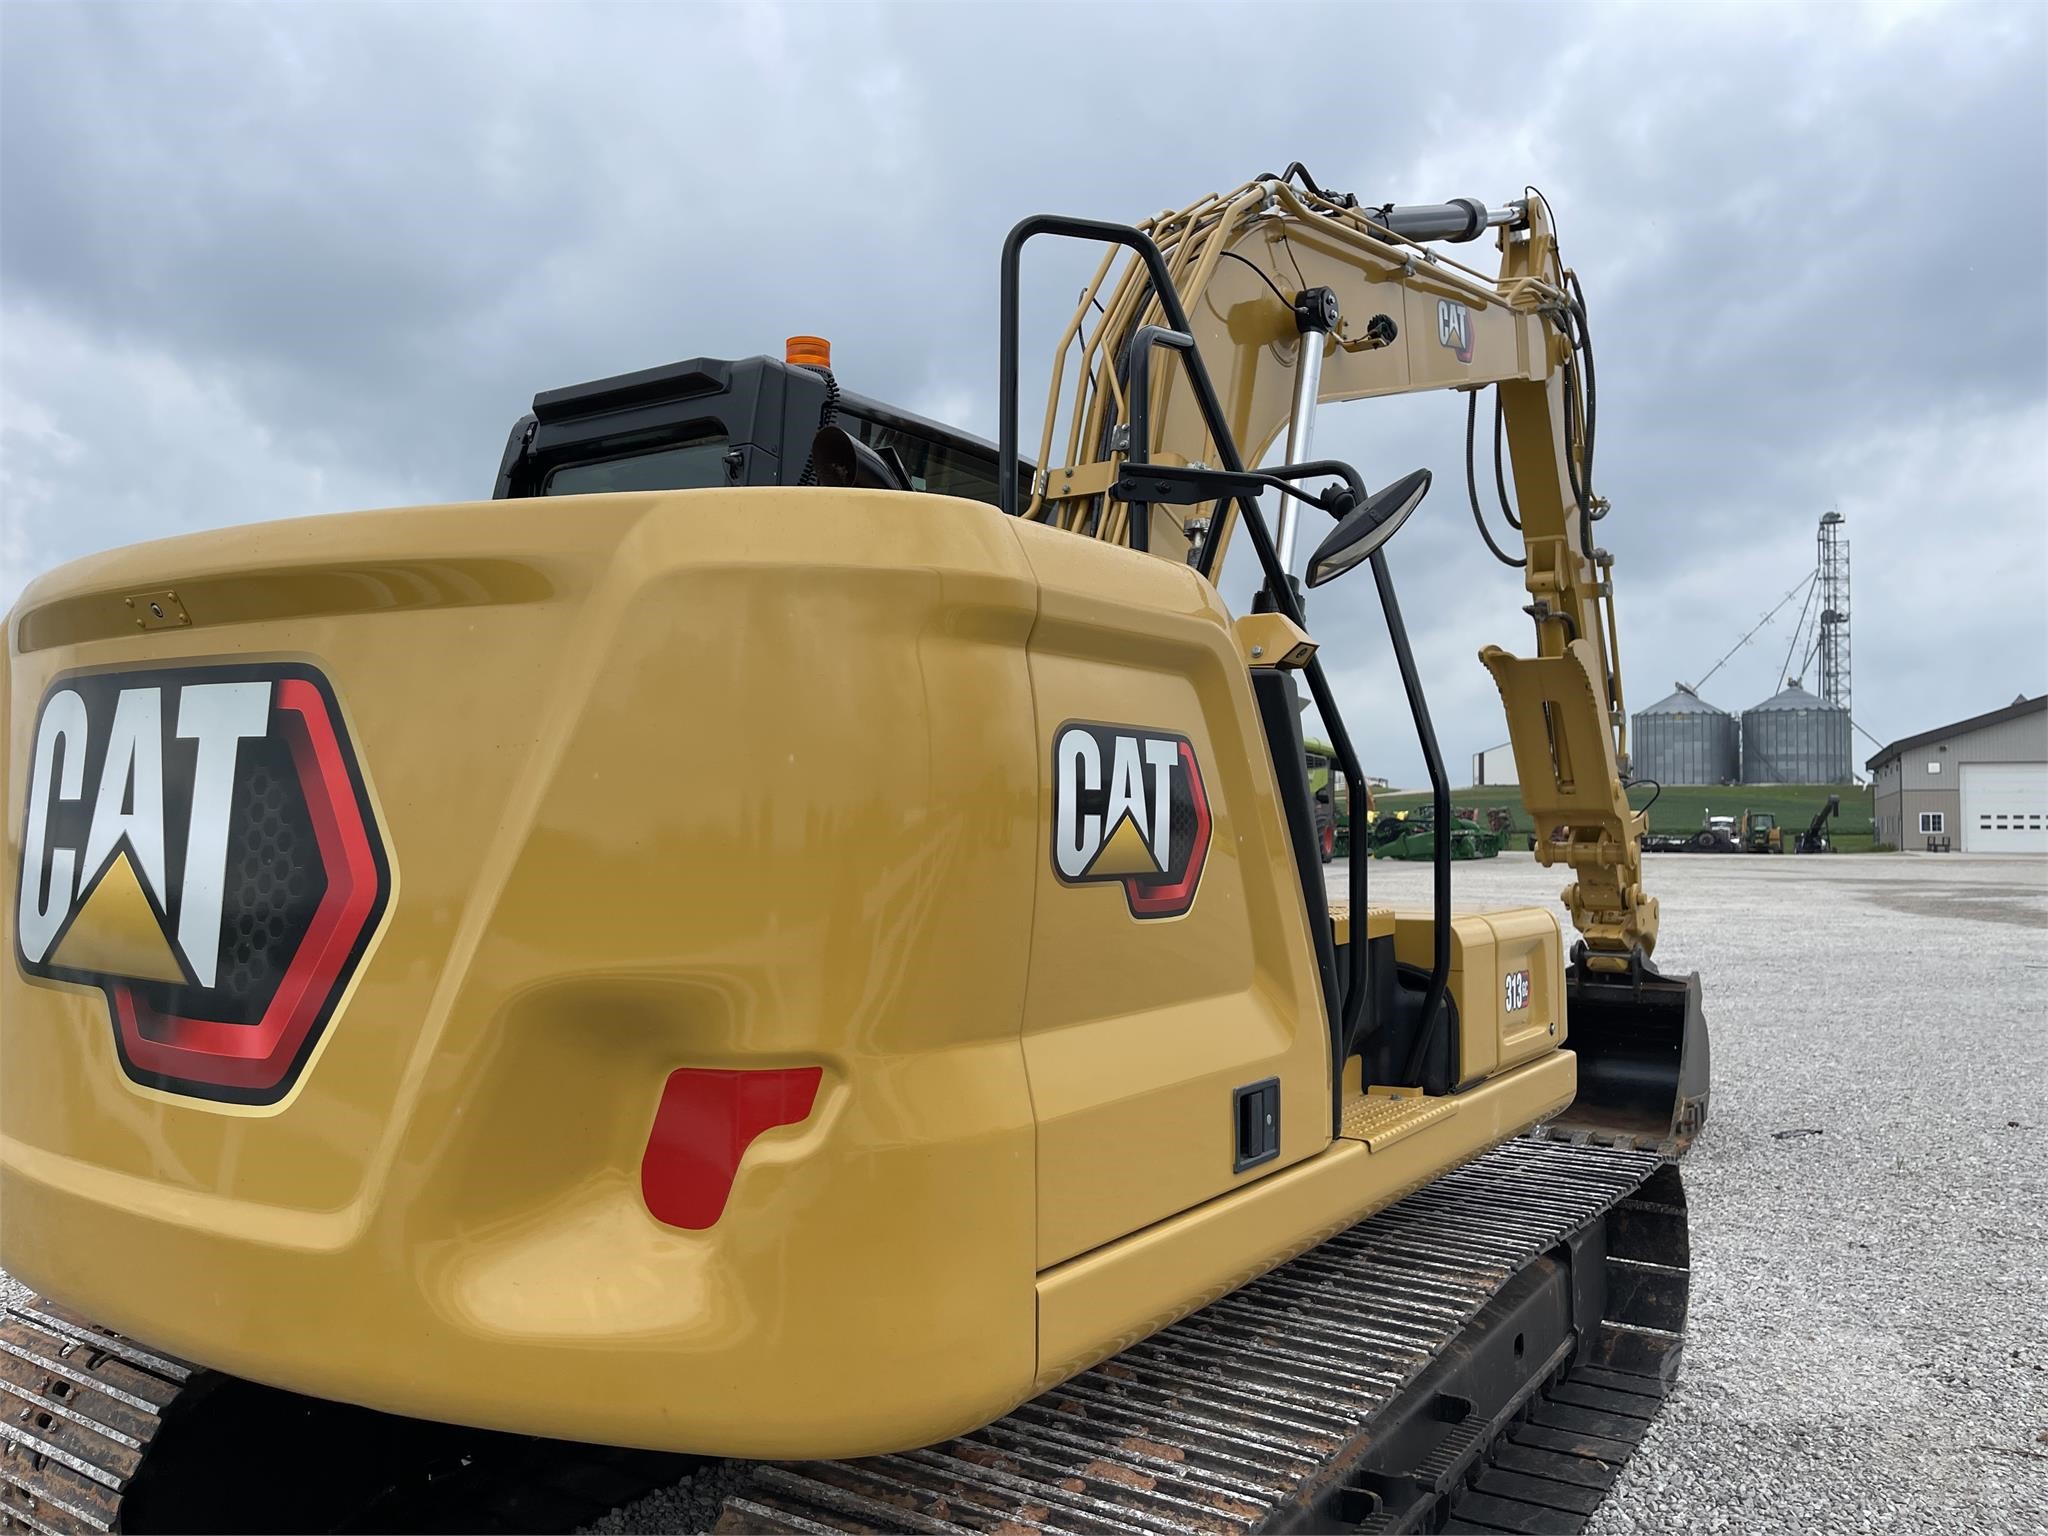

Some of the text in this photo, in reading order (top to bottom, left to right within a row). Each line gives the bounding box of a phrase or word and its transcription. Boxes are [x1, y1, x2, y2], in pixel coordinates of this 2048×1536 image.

[1438, 300, 1466, 349] CAT
[18, 681, 272, 989] CAT
[1057, 729, 1179, 877] CAT
[1505, 972, 1522, 1012] 313
